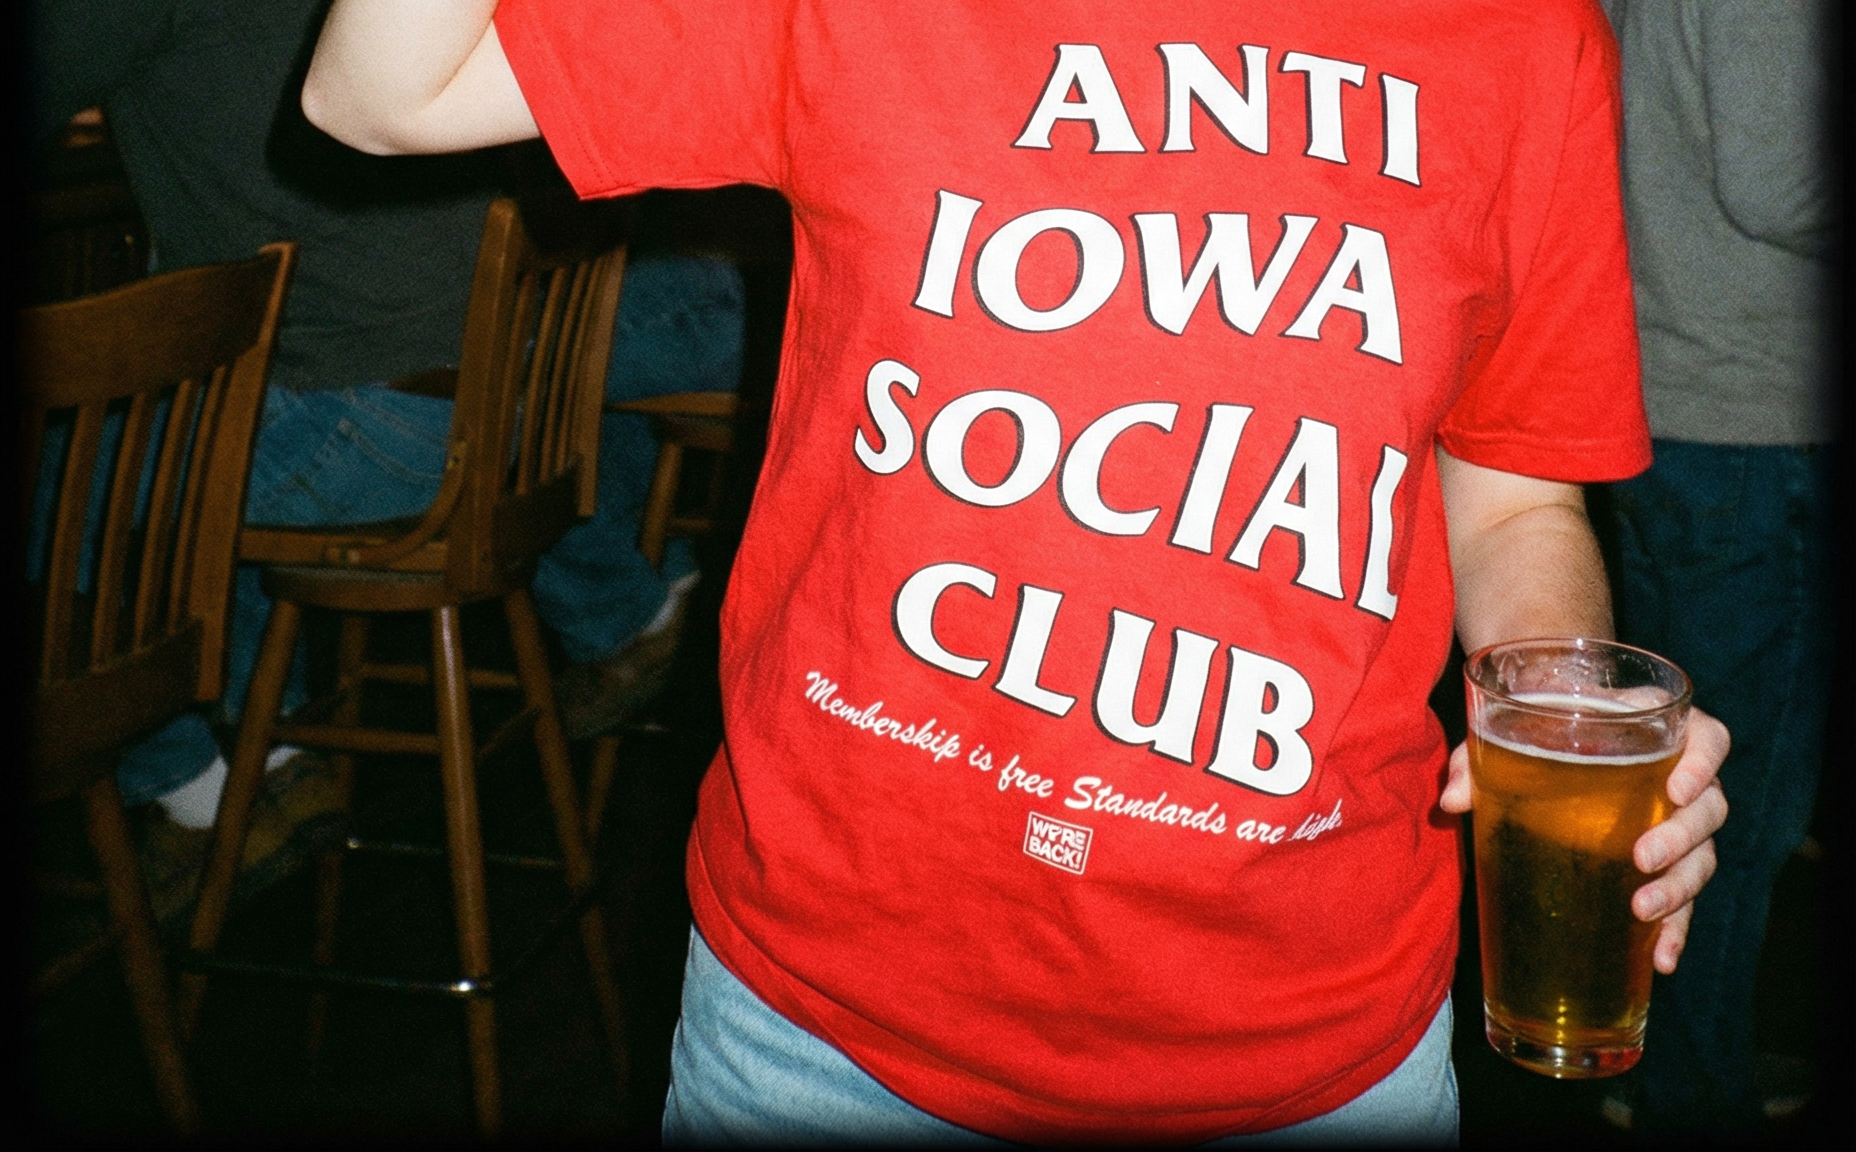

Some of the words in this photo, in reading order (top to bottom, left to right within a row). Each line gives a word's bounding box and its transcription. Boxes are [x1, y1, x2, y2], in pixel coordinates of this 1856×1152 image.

[1011, 42, 1422, 187] ANTI
[914, 189, 1403, 365] IOWA
[854, 358, 1408, 622] SOCIAL
[892, 562, 1316, 796] CLUB
[967, 744, 993, 772] is
[997, 754, 1055, 798] free
[1064, 776, 1227, 834] Standards
[1235, 819, 1287, 844] are
[1028, 835, 1083, 869] BACK!
